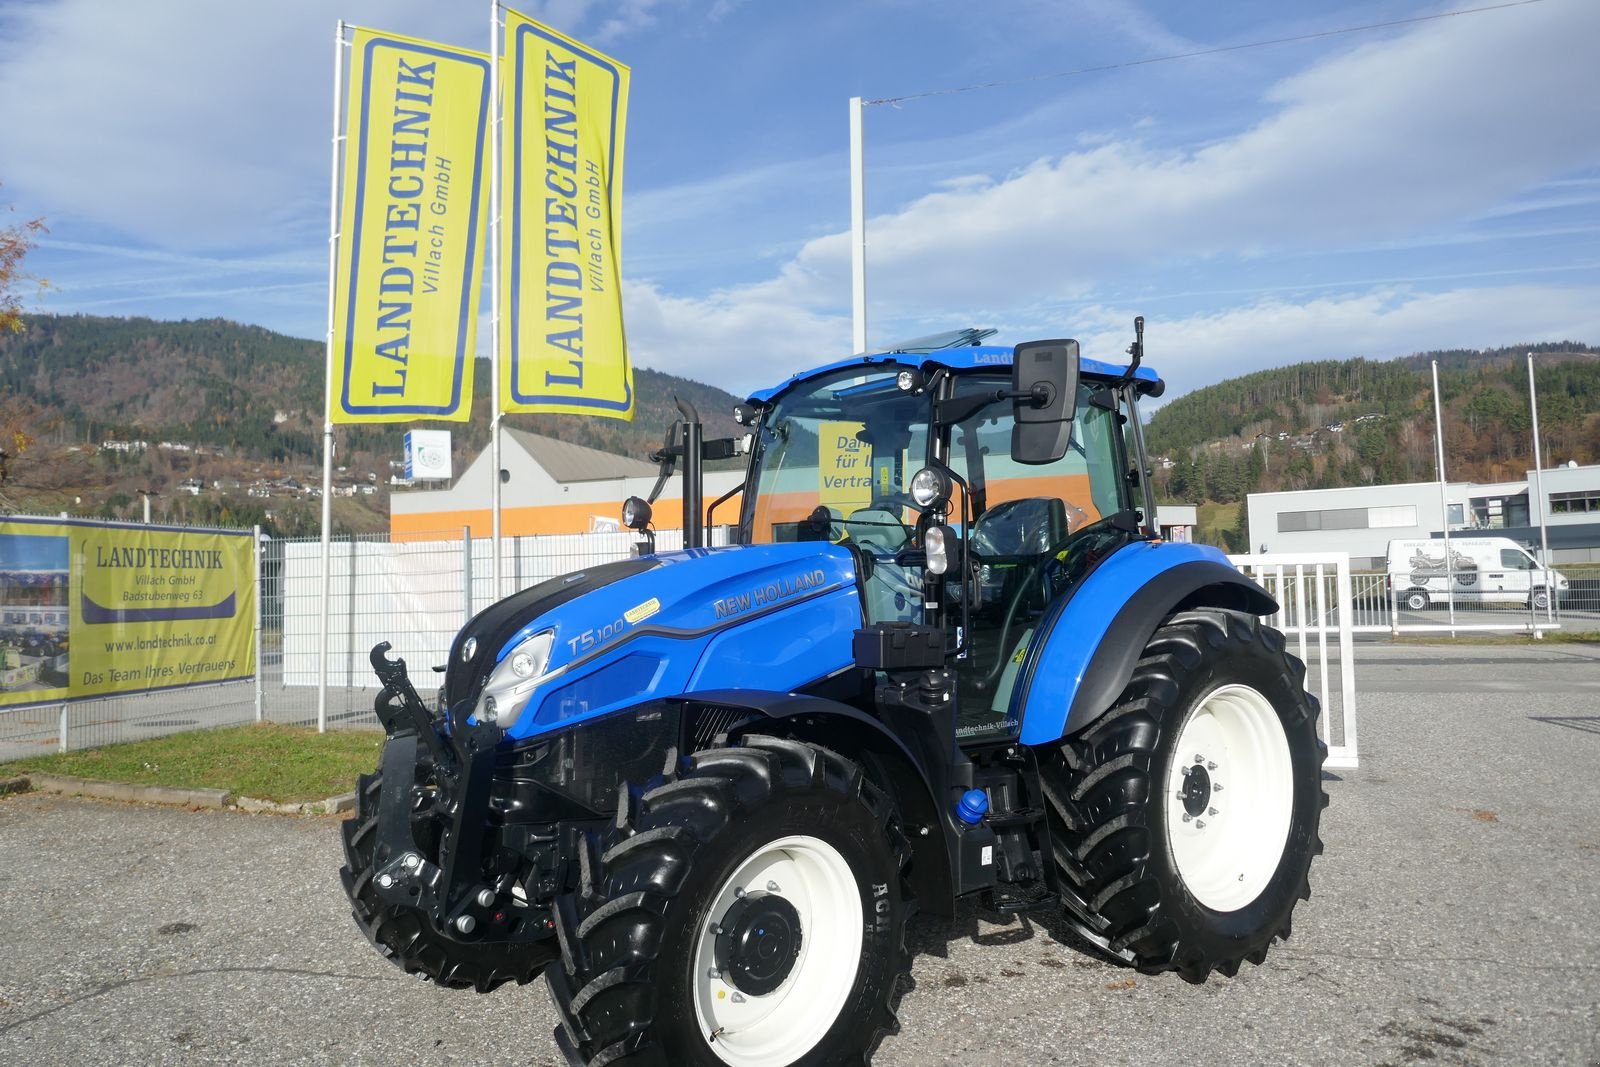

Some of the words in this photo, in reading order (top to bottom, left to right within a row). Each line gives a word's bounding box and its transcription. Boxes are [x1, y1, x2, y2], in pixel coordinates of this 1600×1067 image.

[432, 156, 452, 214] GmbH
[585, 159, 600, 220] GmbH
[372, 57, 437, 398] LANDTECHNIK
[544, 49, 584, 389] LANDTECHNIK
[422, 224, 444, 294] Villach
[588, 224, 605, 293] Villach
[836, 455, 858, 468] für
[96, 546, 223, 569] LANDTECHNIK
[122, 591, 190, 602] Badstubenweg
[192, 590, 204, 600] 63
[135, 575, 165, 586] Villach
[168, 575, 196, 586] GmbH
[714, 592, 752, 619] NEW
[754, 569, 826, 607] HOLLAND
[105, 633, 217, 652] www.landtechnik.co.at
[568, 618, 625, 656] T5.100
[83, 671, 103, 686] Das
[109, 668, 141, 683] Team
[145, 664, 174, 679] Ihres
[178, 659, 236, 676] Vertrauens
